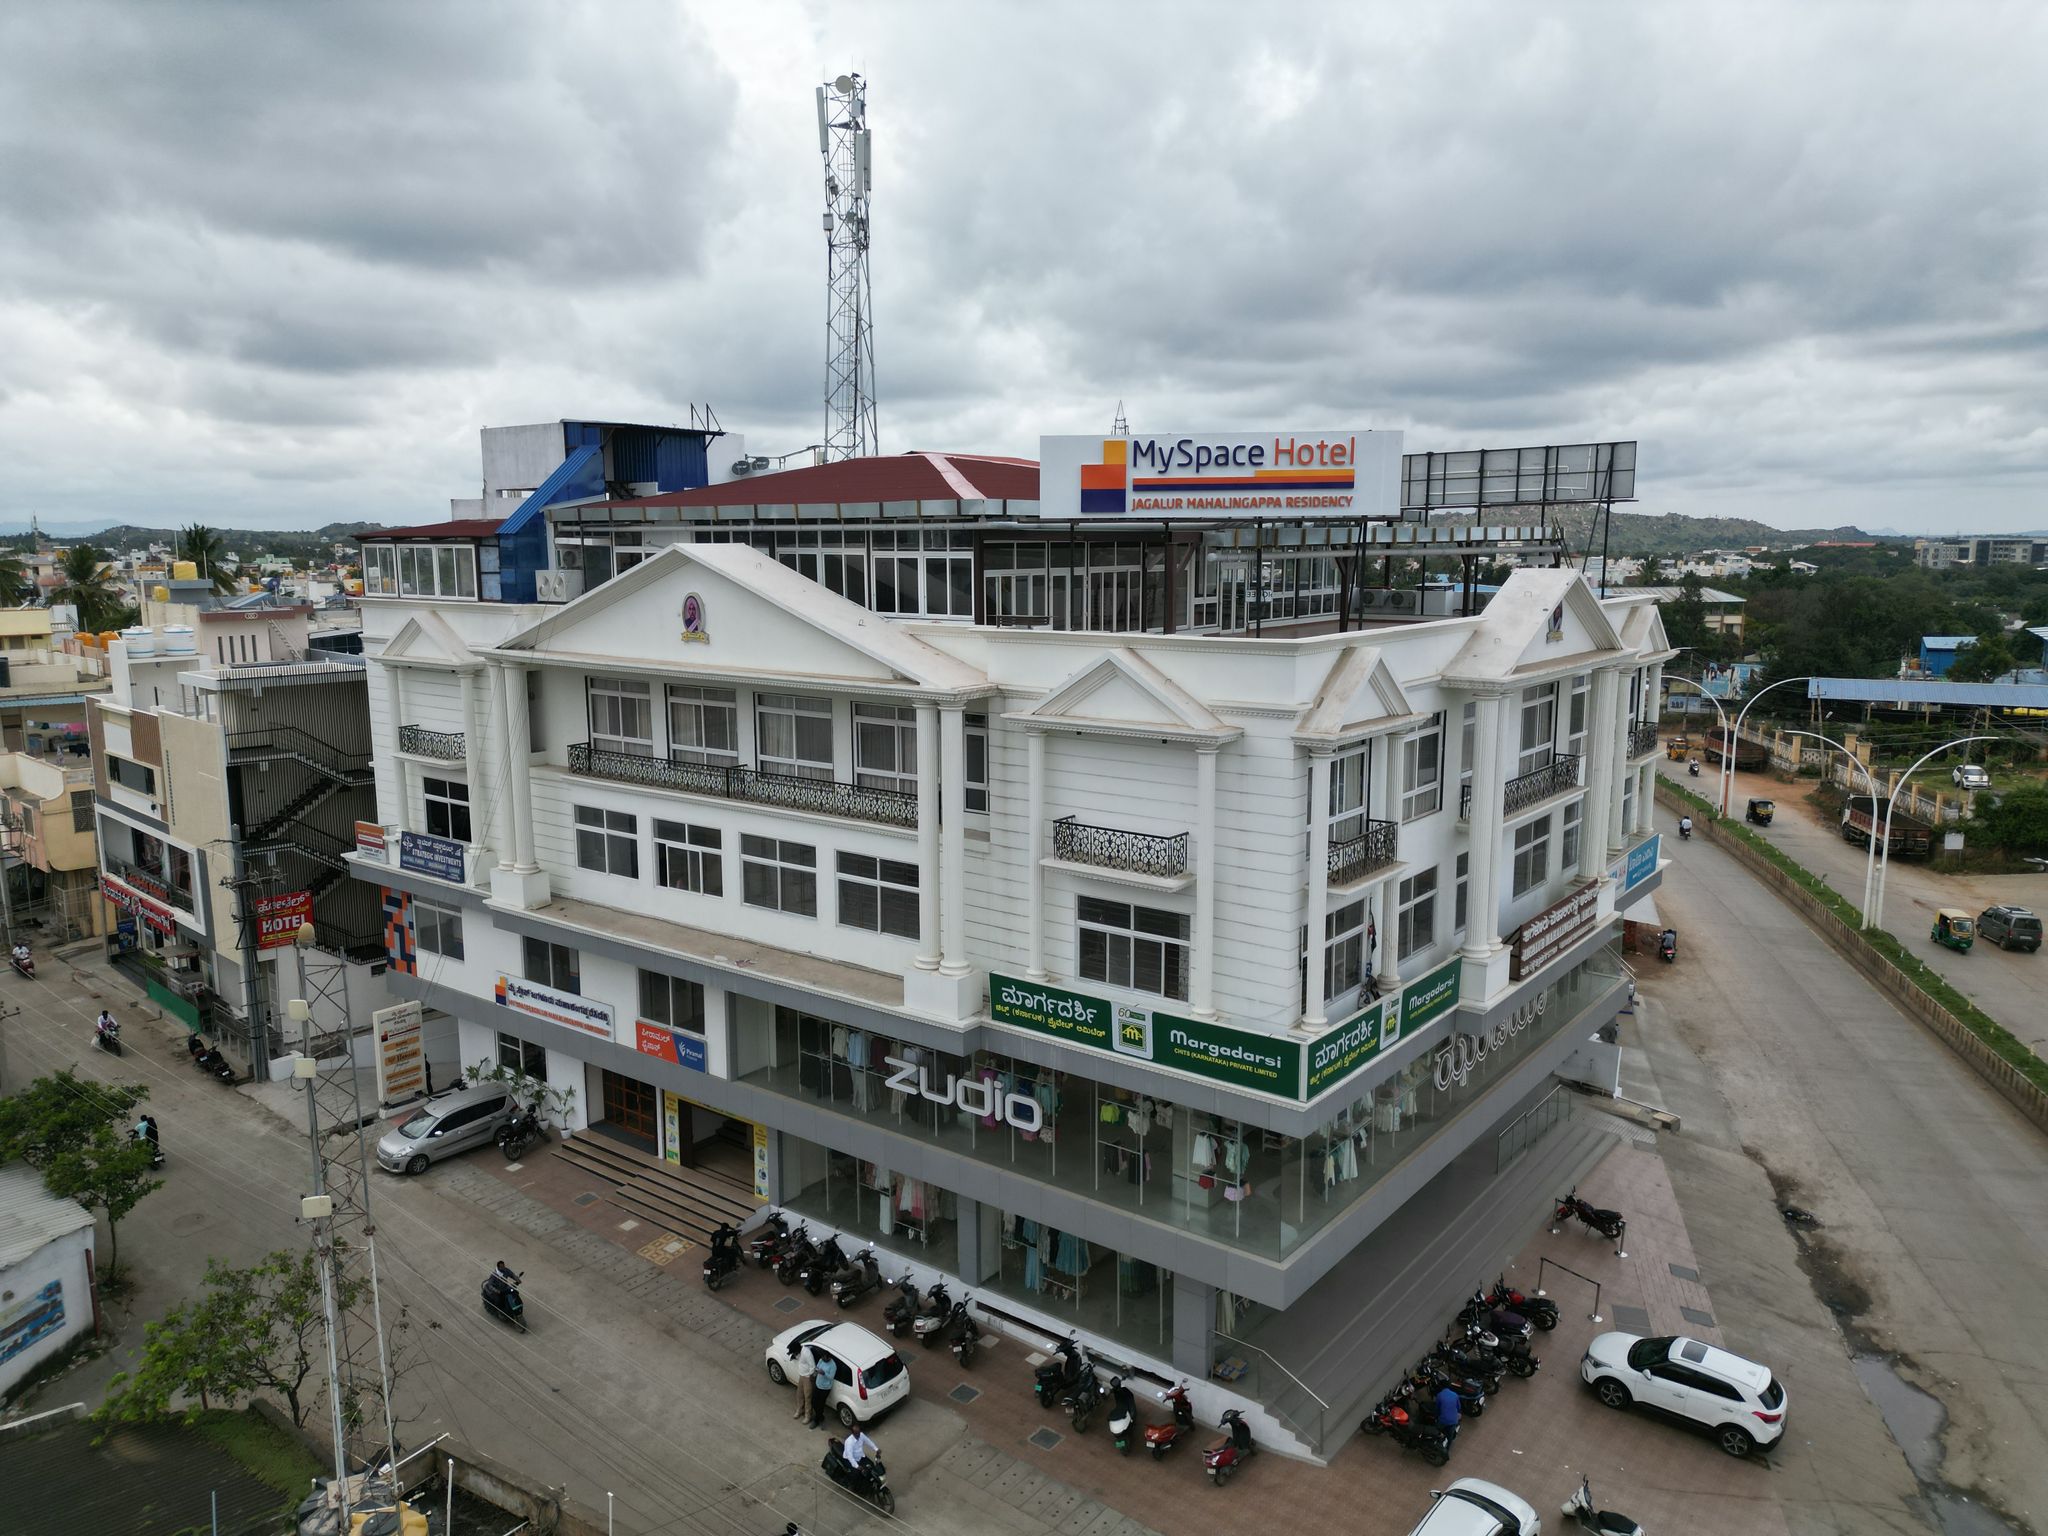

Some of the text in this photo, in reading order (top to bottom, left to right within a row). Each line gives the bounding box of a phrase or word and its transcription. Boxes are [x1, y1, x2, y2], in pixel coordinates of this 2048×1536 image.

[1133, 436, 1356, 474] MySpace Hotel
[1131, 495, 1354, 512] JAGALUR MAHALINGAPPA RESIDENCY
[1001, 985, 1098, 1024] ಮಾರ್ಗದರ್ಶಿ
[1408, 973, 1455, 1011] Margadarsi
[686, 1048, 703, 1059] Piramal
[1170, 1029, 1282, 1069] Margadarsi
[1174, 1047, 1278, 1079] CHITS (KARNATAKA) PRIVATE LIMITED
[1315, 1019, 1375, 1069] ಮಾರ್ಗದರ್ಶಿ
